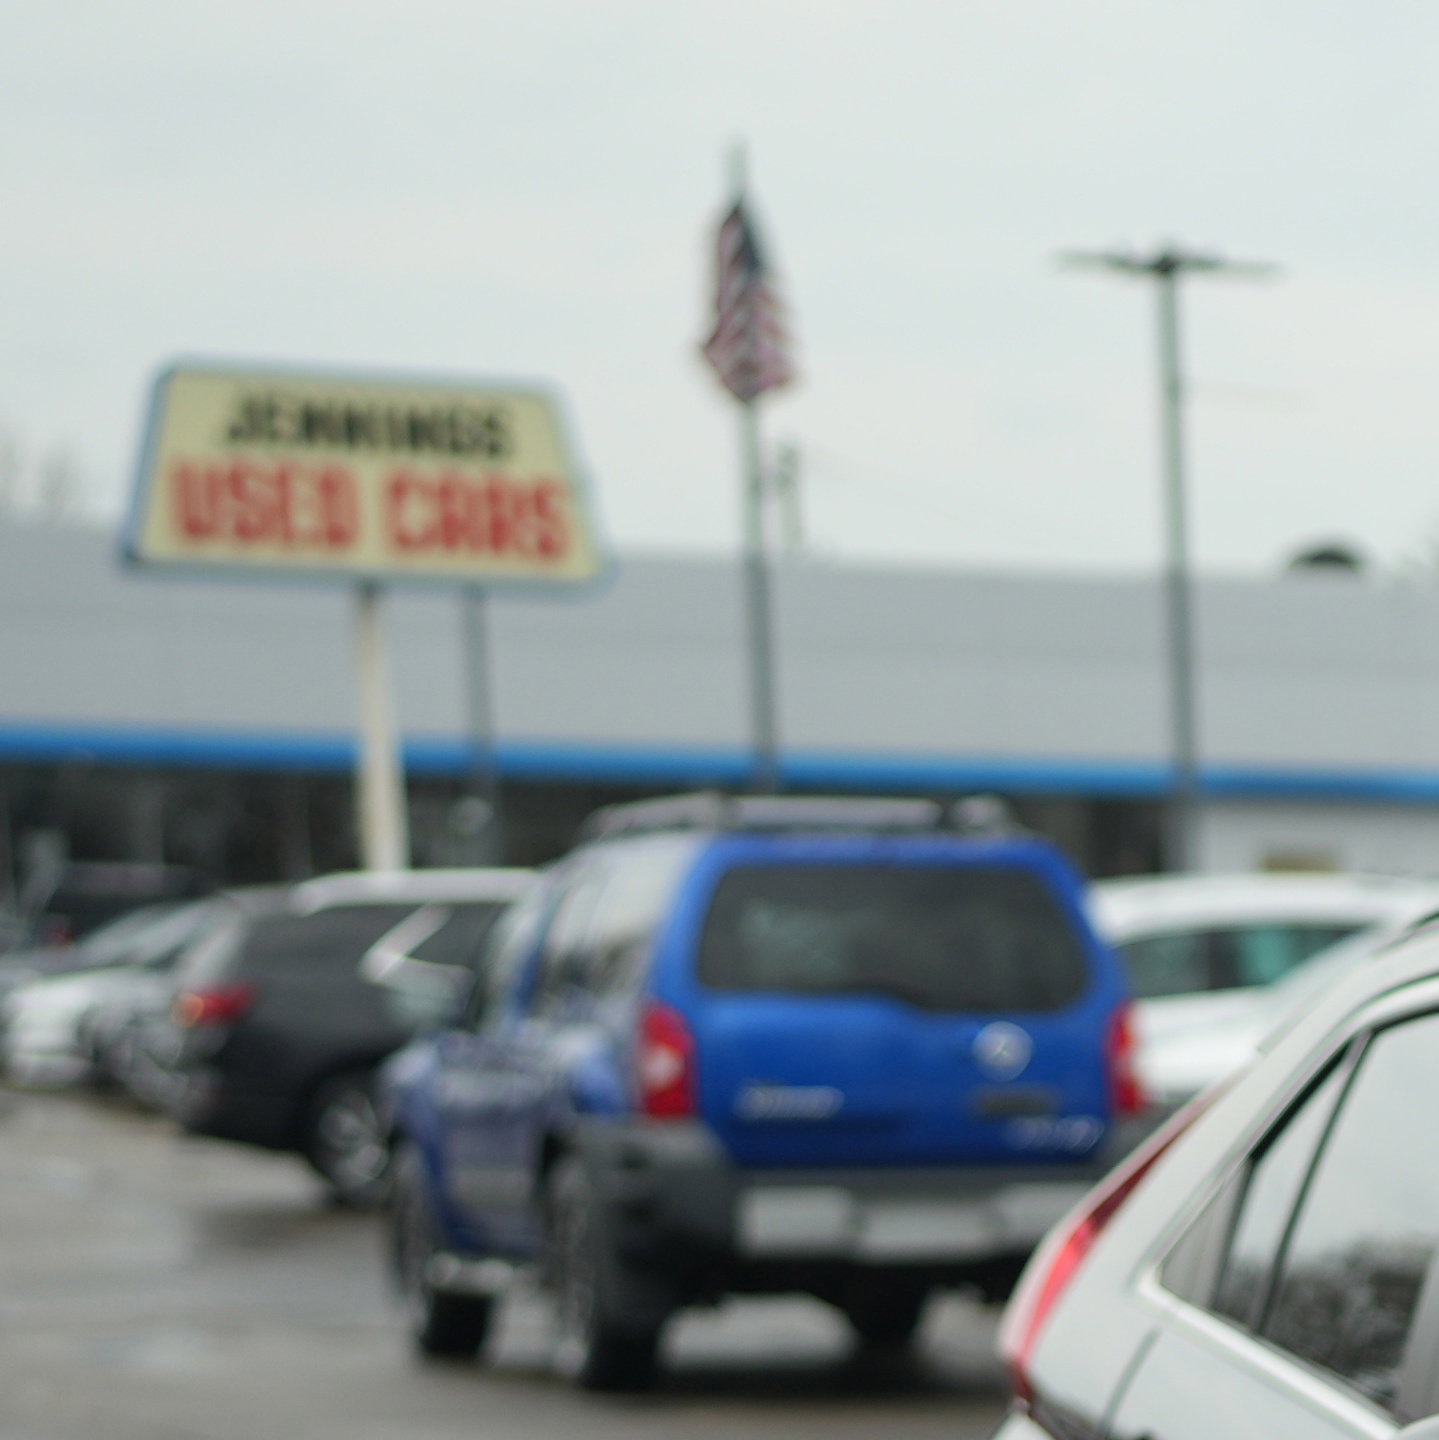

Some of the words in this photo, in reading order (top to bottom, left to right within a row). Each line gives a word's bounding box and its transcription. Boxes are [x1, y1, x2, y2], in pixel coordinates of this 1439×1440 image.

[229, 398, 511, 458] JENNINGS
[172, 463, 357, 545] USED
[384, 470, 570, 562] CARS
